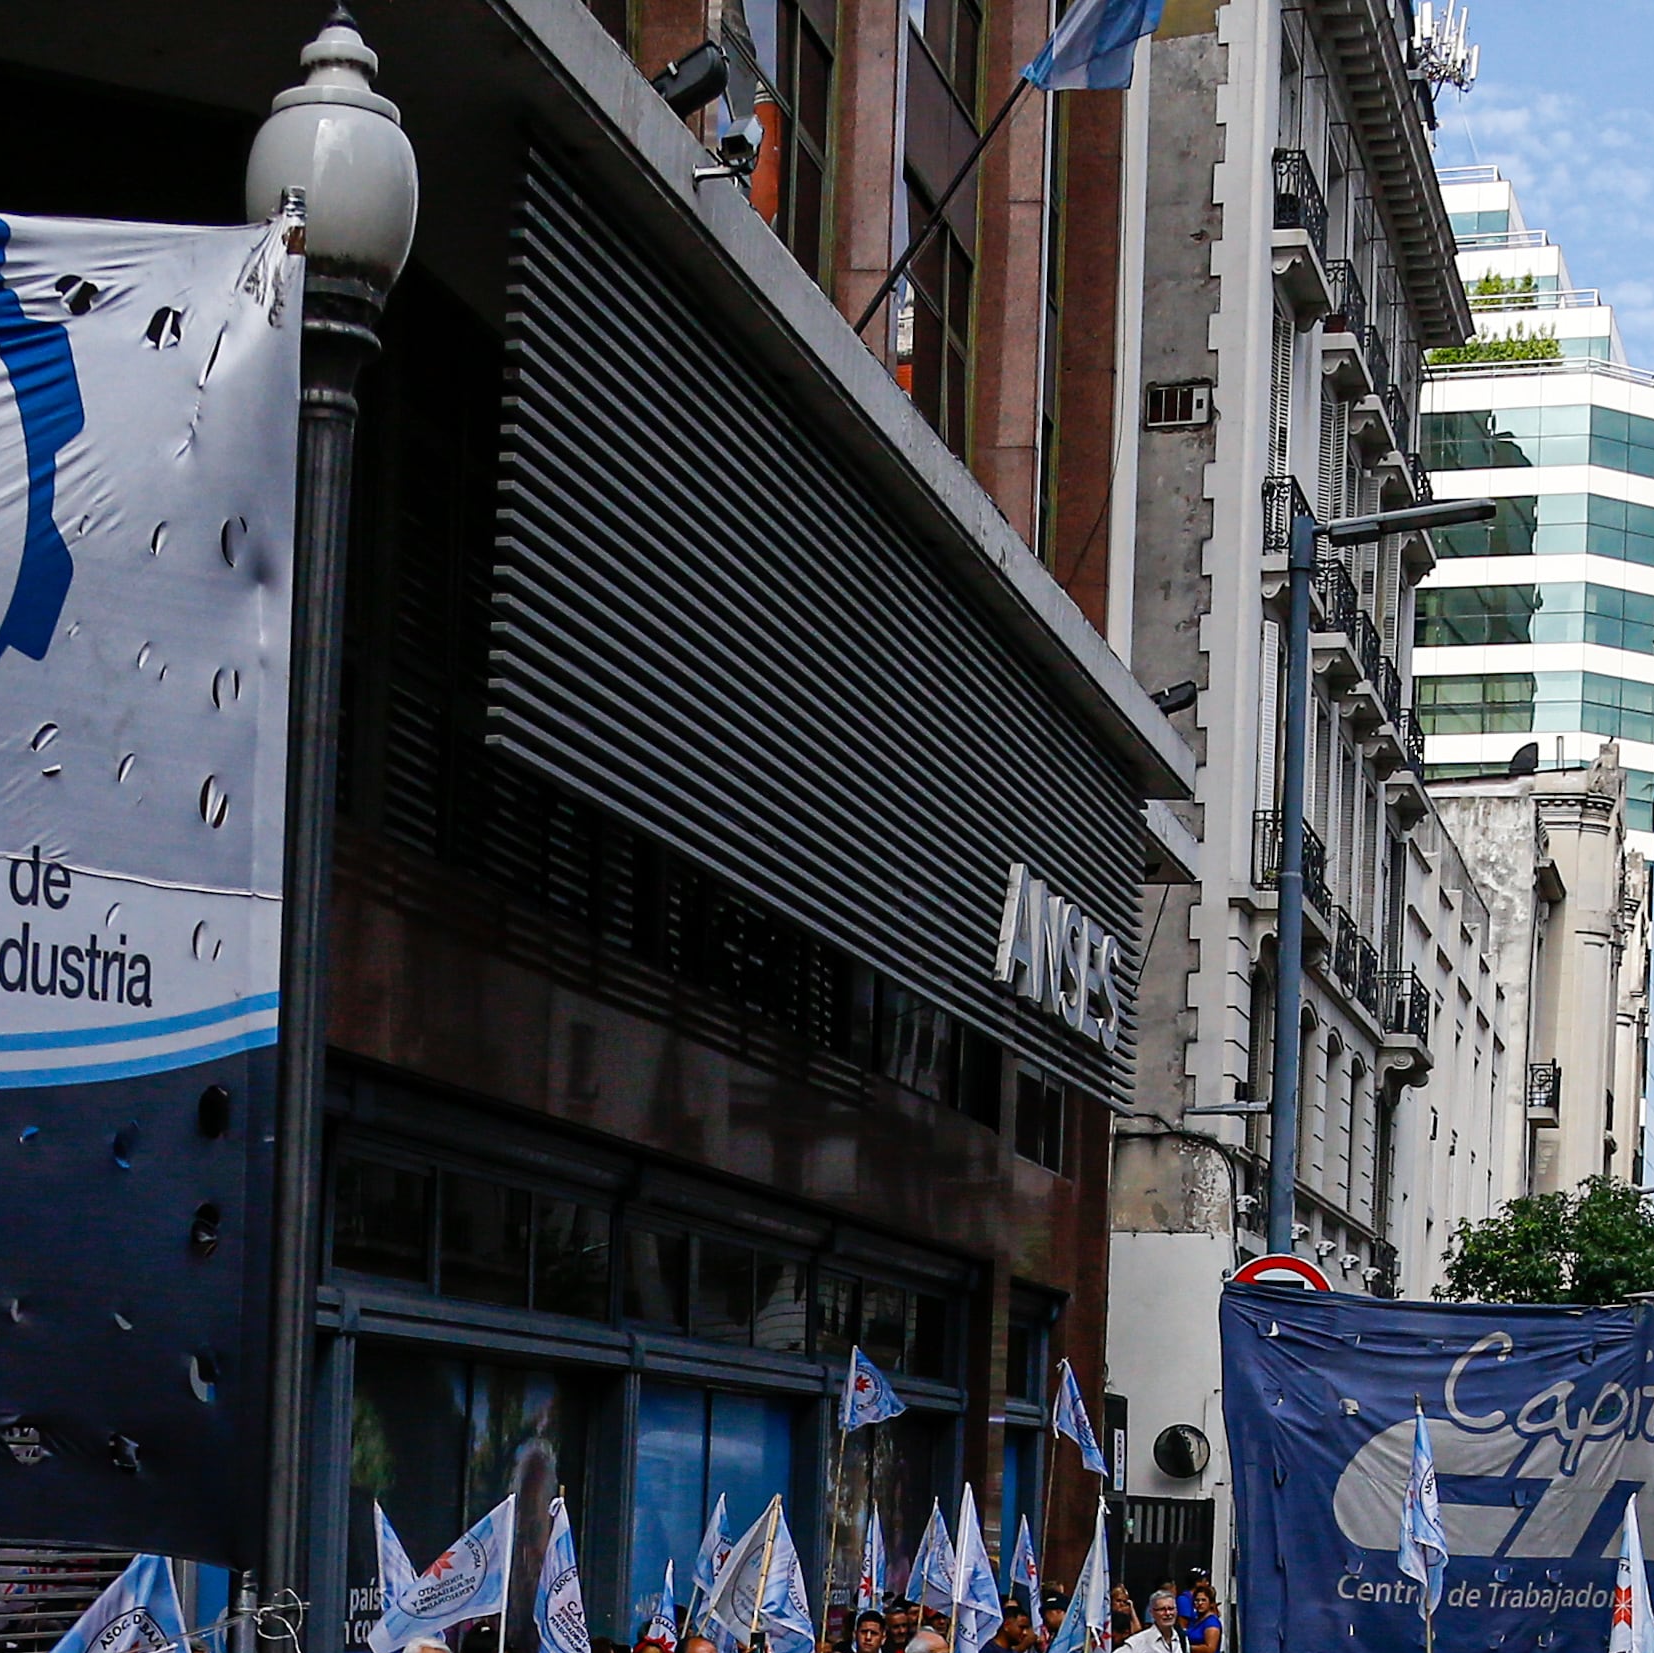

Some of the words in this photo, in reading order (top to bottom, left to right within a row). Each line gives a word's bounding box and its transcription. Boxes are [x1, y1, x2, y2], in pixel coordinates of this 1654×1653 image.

[9, 845, 72, 909] de
[993, 862, 1119, 1052] ANSES
[1447, 1577, 1482, 1607] de
